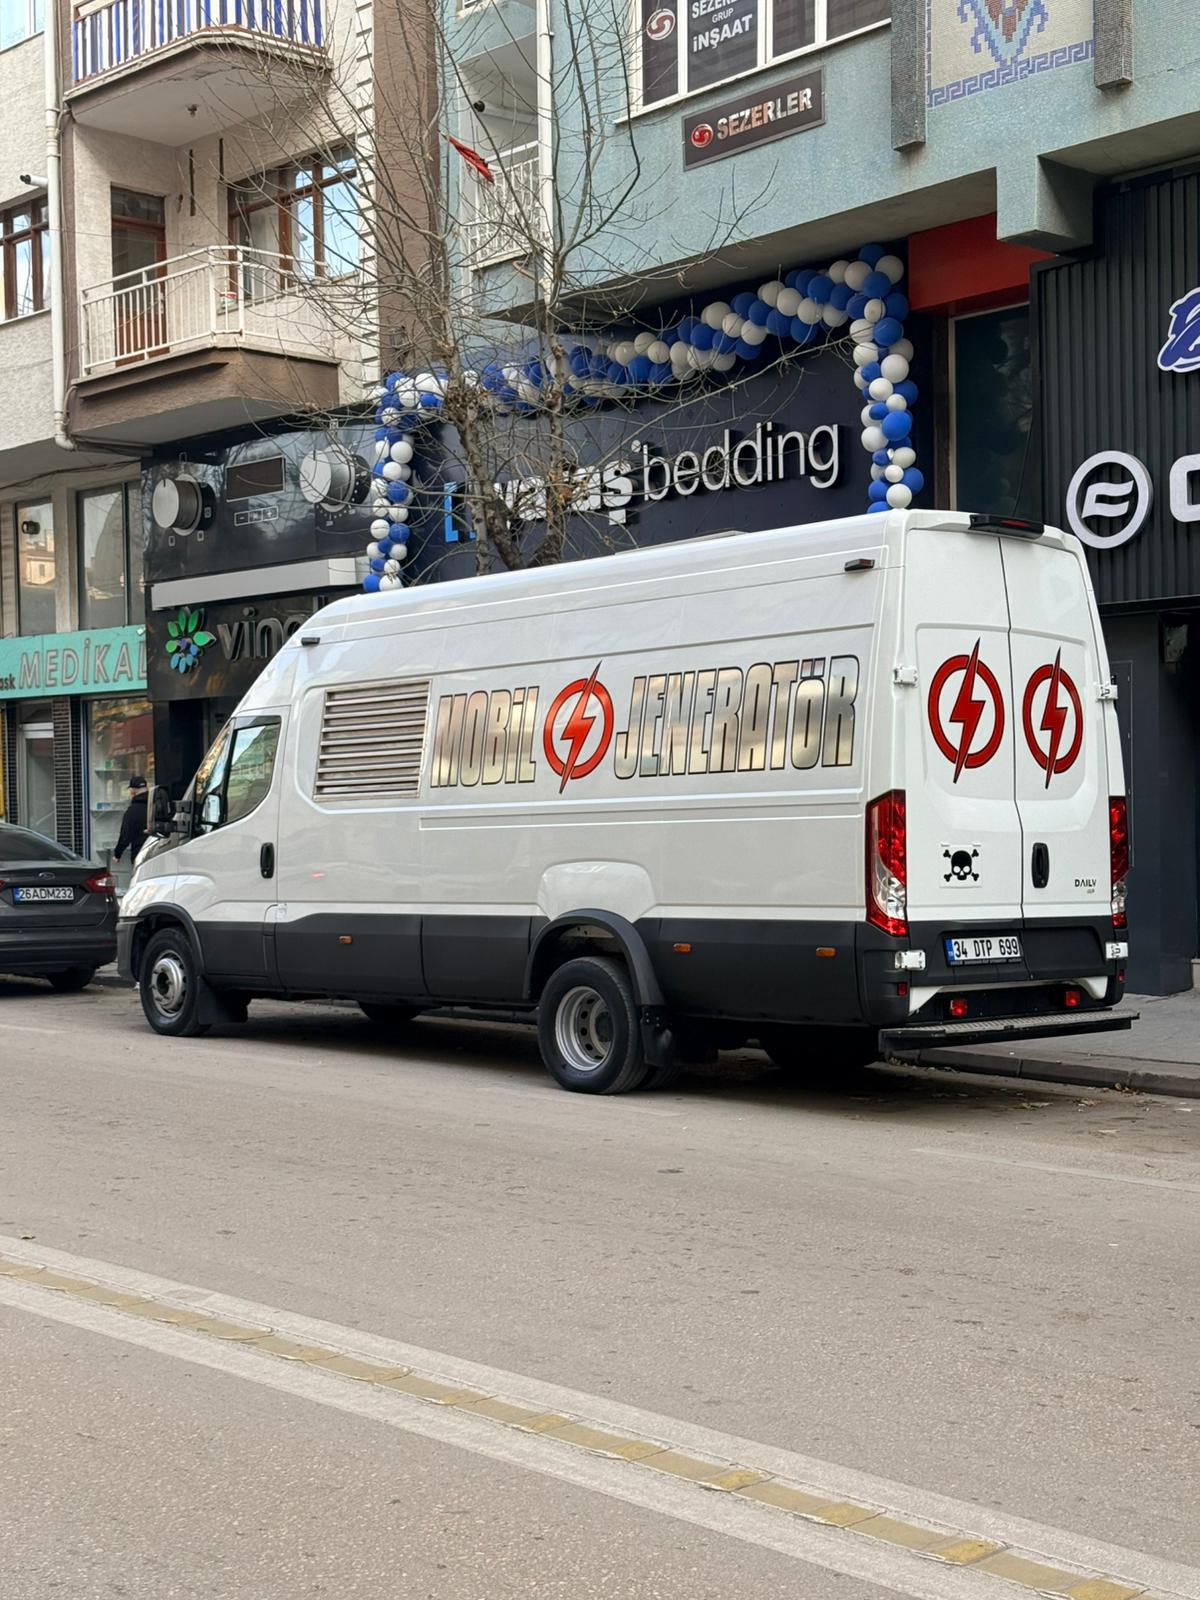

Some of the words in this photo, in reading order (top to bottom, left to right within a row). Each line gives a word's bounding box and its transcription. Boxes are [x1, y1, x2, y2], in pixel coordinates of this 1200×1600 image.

[711, 7, 734, 23] GRUP
[716, 87, 813, 140] SEZERLER
[643, 421, 839, 501] bedding
[19, 637, 147, 690] MEDİKAL
[613, 654, 860, 780] JENERATÖR
[1074, 879, 1097, 888] DAILY
[953, 941, 968, 958] 34
[973, 939, 993, 957] DTP
[999, 938, 1019, 956] 699
